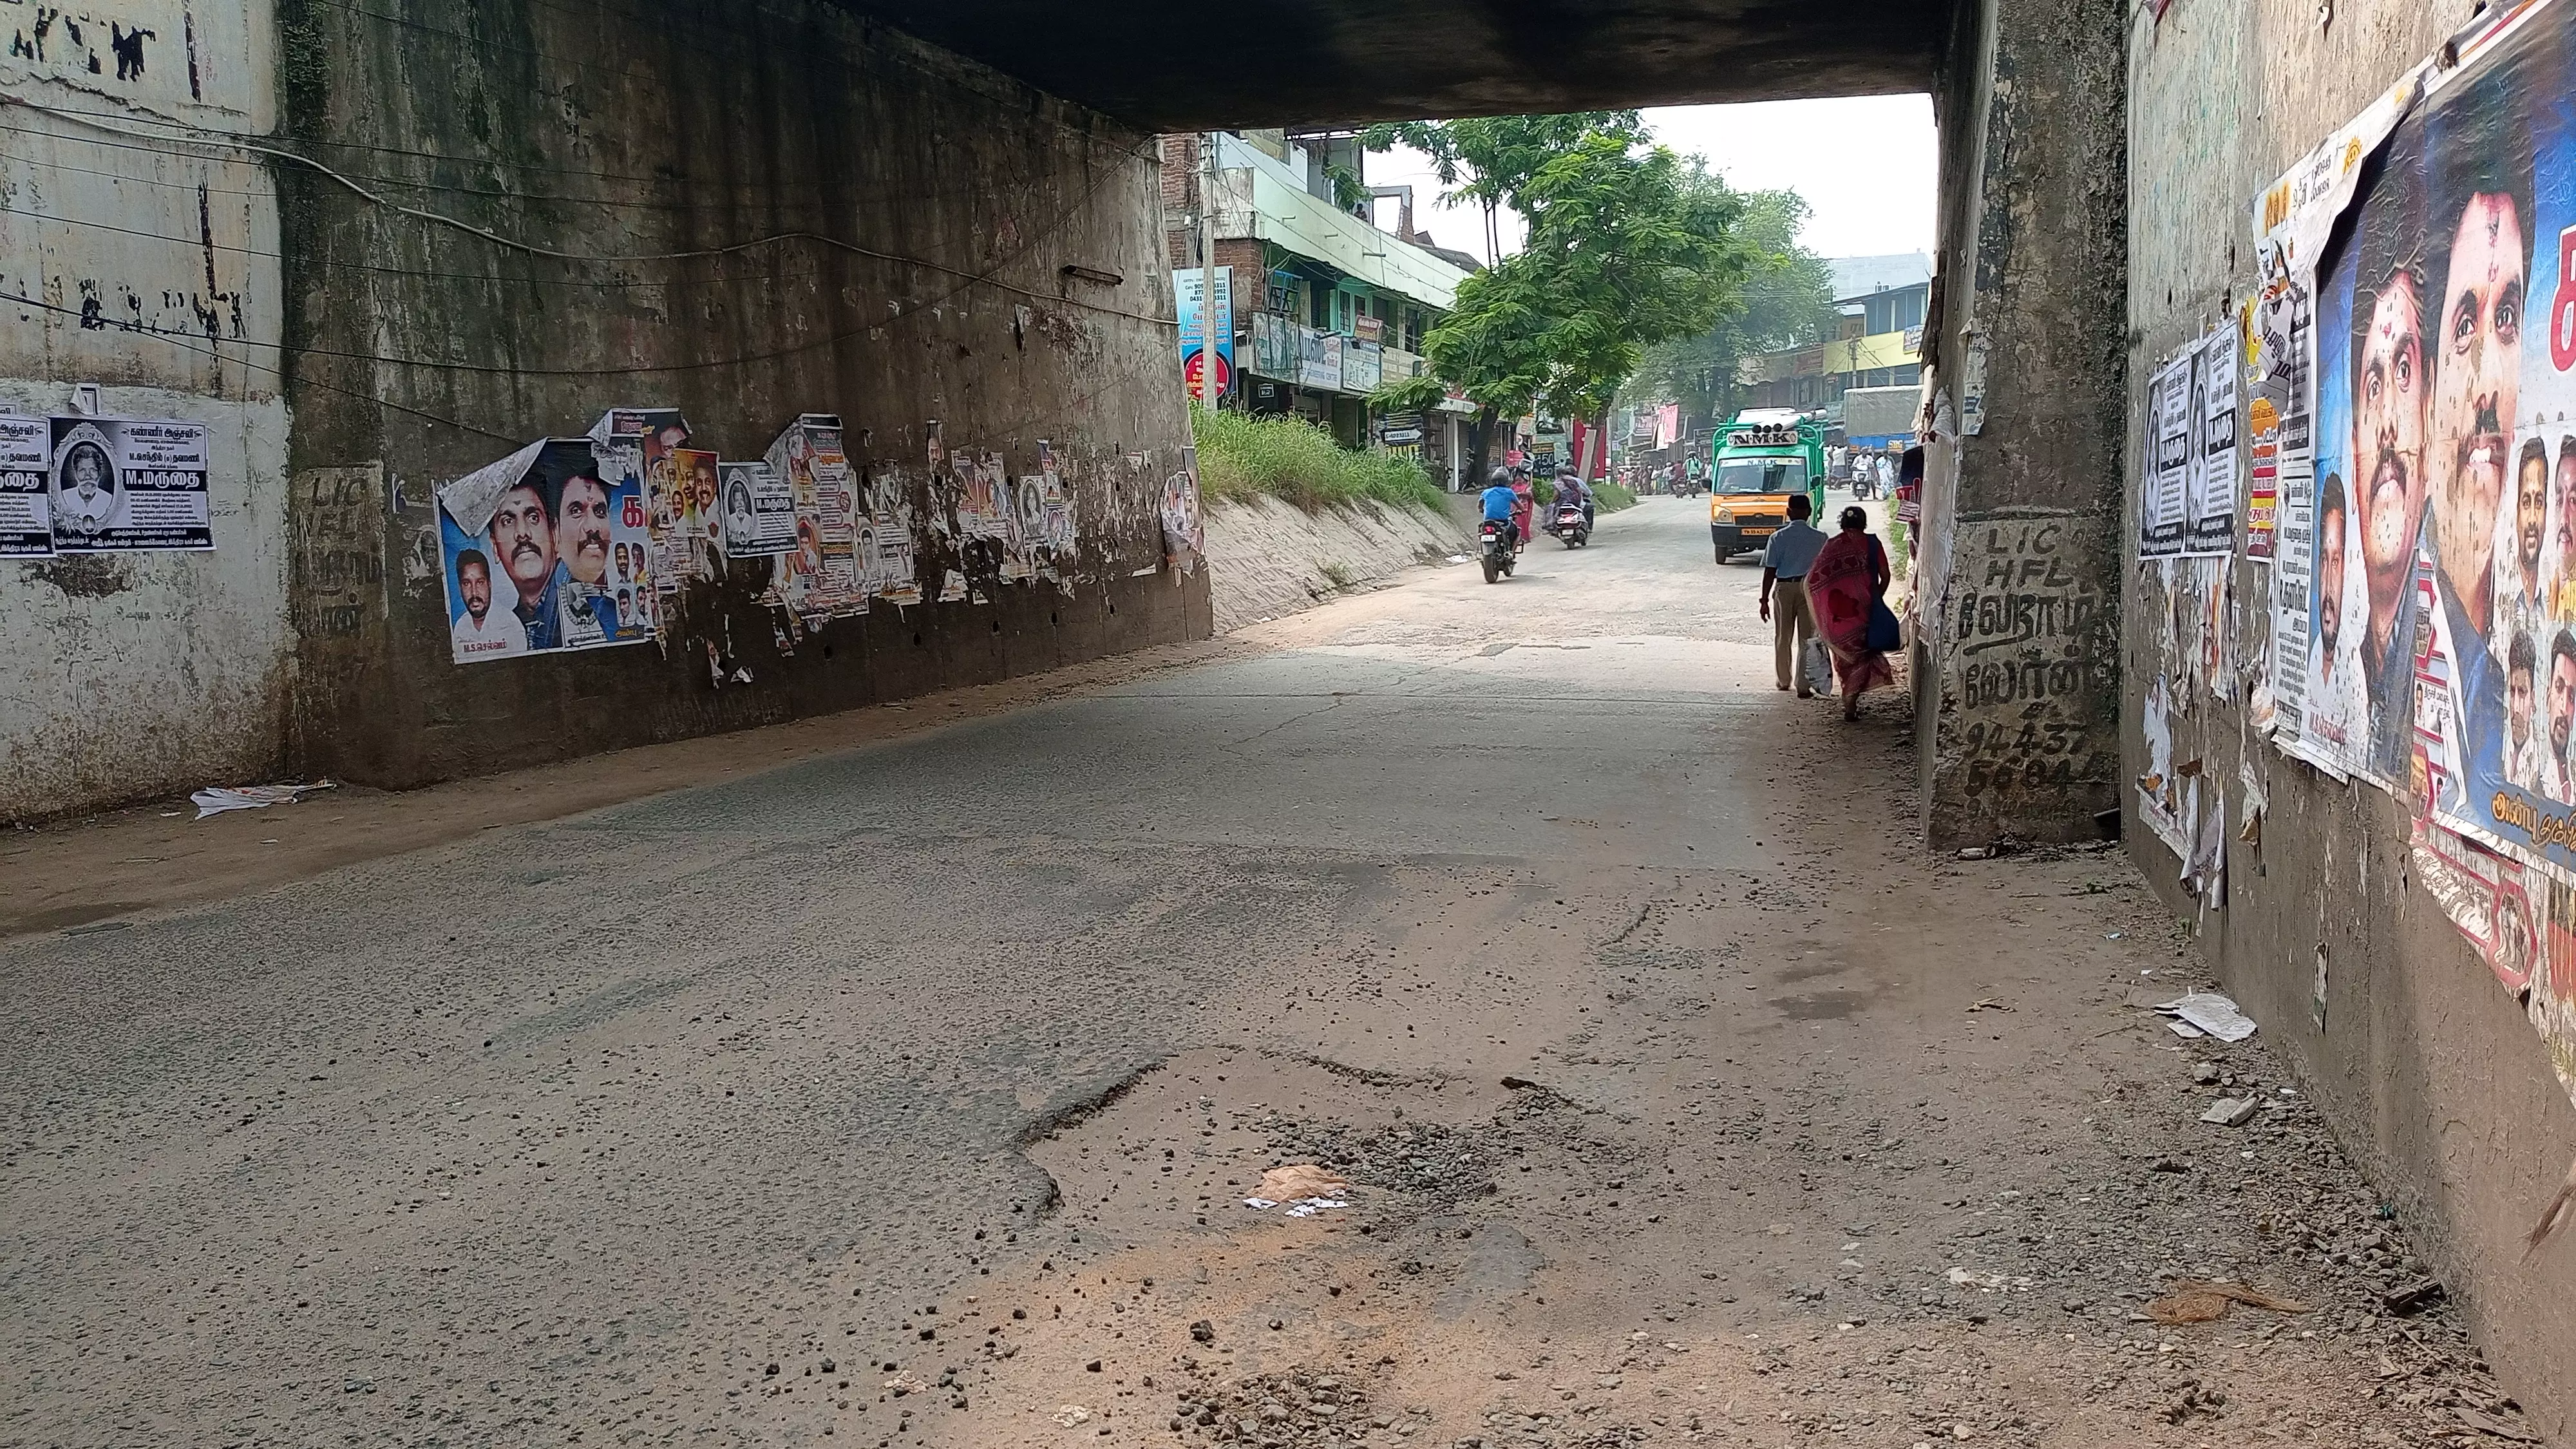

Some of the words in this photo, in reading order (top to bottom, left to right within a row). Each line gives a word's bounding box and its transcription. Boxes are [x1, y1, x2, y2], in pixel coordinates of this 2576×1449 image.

[131, 425, 163, 437] கண்ணீர்
[164, 427, 193, 439] அஞ்சலி
[126, 470, 200, 489] M.மருதை
[1985, 524, 2061, 555] LIC
[1984, 556, 2074, 591] HFL
[1965, 721, 2088, 759] 94437
[2491, 791, 2538, 845] அன்பு
